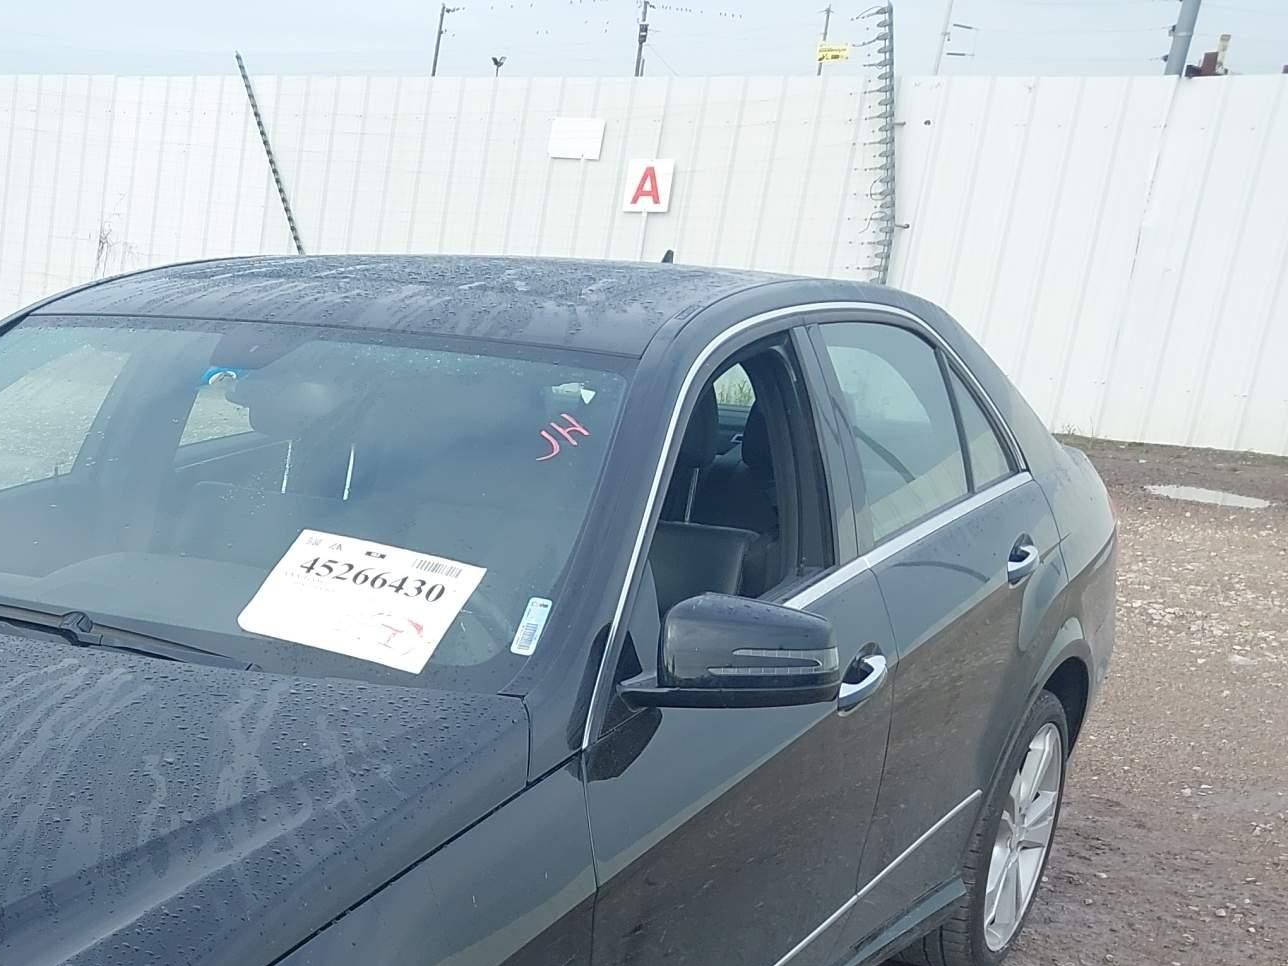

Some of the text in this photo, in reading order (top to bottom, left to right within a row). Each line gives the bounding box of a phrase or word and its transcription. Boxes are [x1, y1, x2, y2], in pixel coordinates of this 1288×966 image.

[630, 166, 661, 205] A
[535, 413, 590, 461] JH
[299, 556, 446, 603] 45266430
